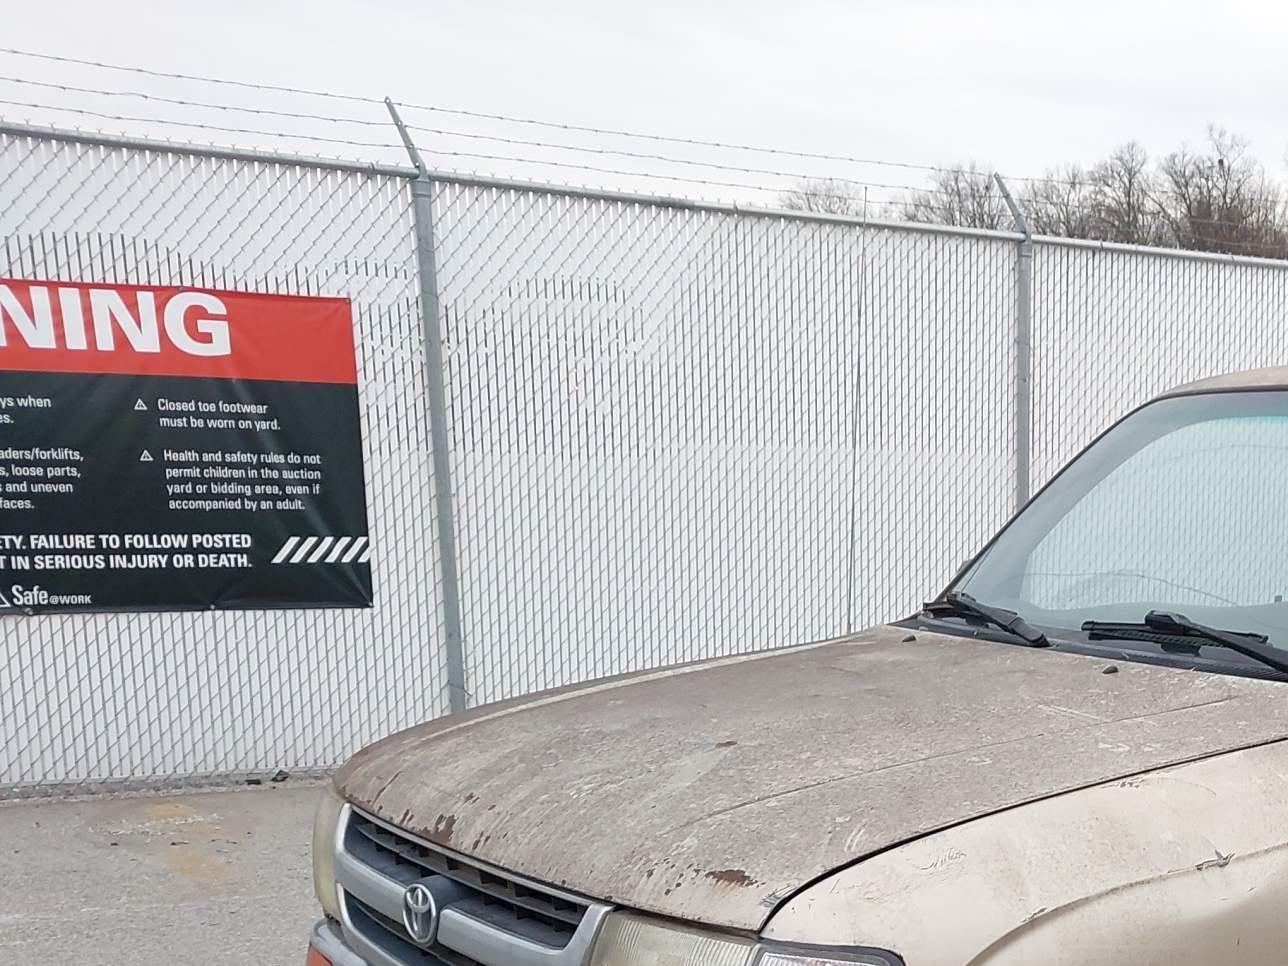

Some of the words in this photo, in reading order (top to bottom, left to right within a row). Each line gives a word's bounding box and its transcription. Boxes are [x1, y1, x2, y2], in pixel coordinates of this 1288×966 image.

[16, 395, 51, 408] when
[157, 398, 196, 412] Closed
[198, 401, 216, 412] toe
[219, 401, 269, 414] footwear
[159, 416, 188, 428] must
[190, 416, 204, 428] be
[207, 419, 236, 429] worn
[238, 419, 253, 430] on
[254, 418, 281, 431] yard.
[163, 449, 199, 463] Health
[202, 451, 222, 463] and
[225, 450, 258, 465] safety
[260, 451, 285, 464] rules
[287, 452, 300, 465] do
[303, 454, 322, 465] not
[11, 464, 43, 476] loose
[47, 466, 81, 479] parts,
[165, 467, 201, 480] permit
[203, 466, 246, 479] children
[248, 468, 258, 479] in
[261, 468, 279, 479] the
[282, 469, 321, 480] auction
[5, 481, 27, 493] and
[31, 483, 73, 493] uneven
[166, 482, 192, 496] yard
[196, 484, 208, 494] or
[211, 482, 251, 497] bidding
[255, 484, 283, 495] area,
[285, 485, 309, 495] even
[312, 483, 321, 495] if
[169, 498, 242, 512] accompanied
[244, 499, 258, 512] by
[260, 501, 273, 510] an
[276, 499, 305, 510] adult.
[30, 534, 96, 549] FAILURE
[99, 534, 121, 549] TO
[124, 534, 188, 549] FOLLOW
[192, 534, 252, 548] POSTED
[11, 555, 30, 570] IN
[34, 555, 105, 570] SERIOUS
[109, 554, 168, 569] INJURY
[172, 554, 194, 569] OR
[198, 553, 253, 568] DEATH.
